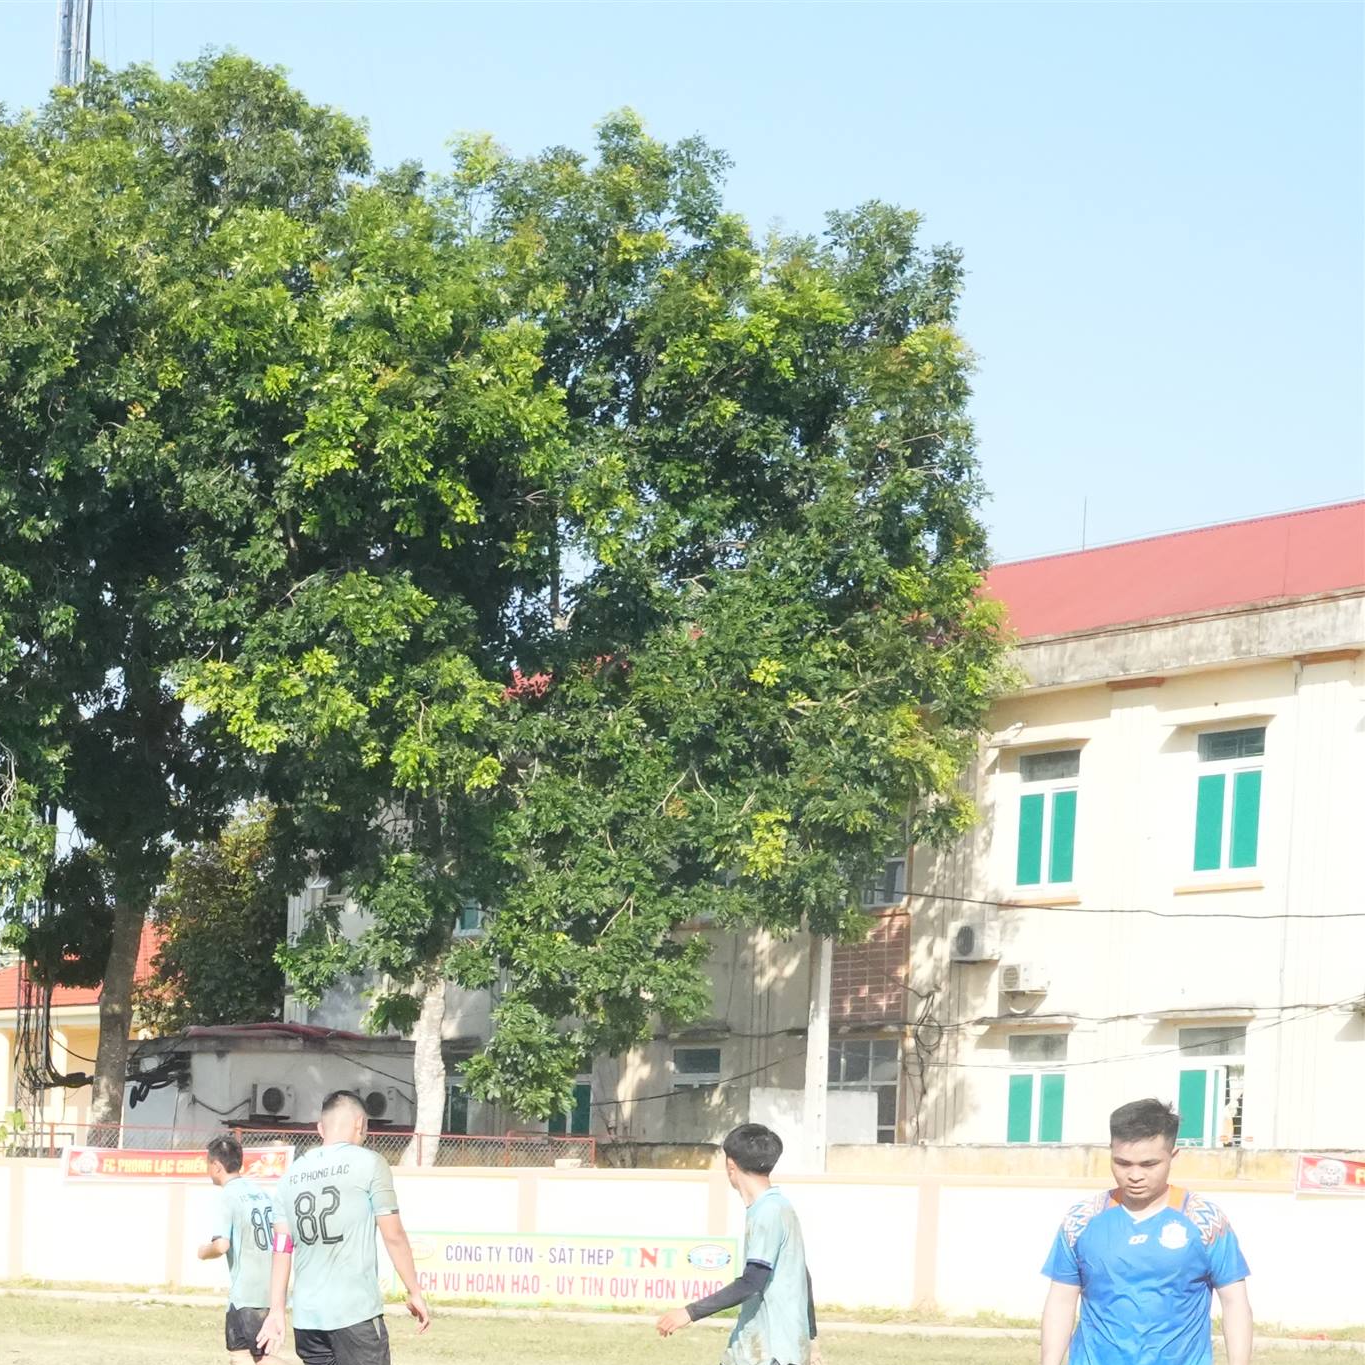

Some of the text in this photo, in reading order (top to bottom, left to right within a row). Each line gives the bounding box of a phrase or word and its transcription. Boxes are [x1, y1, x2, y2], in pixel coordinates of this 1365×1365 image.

[102, 1159, 116, 1173] FC
[117, 1159, 152, 1174] PHONG
[300, 1167, 329, 1183] PHONG
[294, 1185, 344, 1246] 82
[487, 1246, 502, 1263] TY
[620, 1246, 678, 1269] TNT
[556, 1276, 575, 1296] UY
